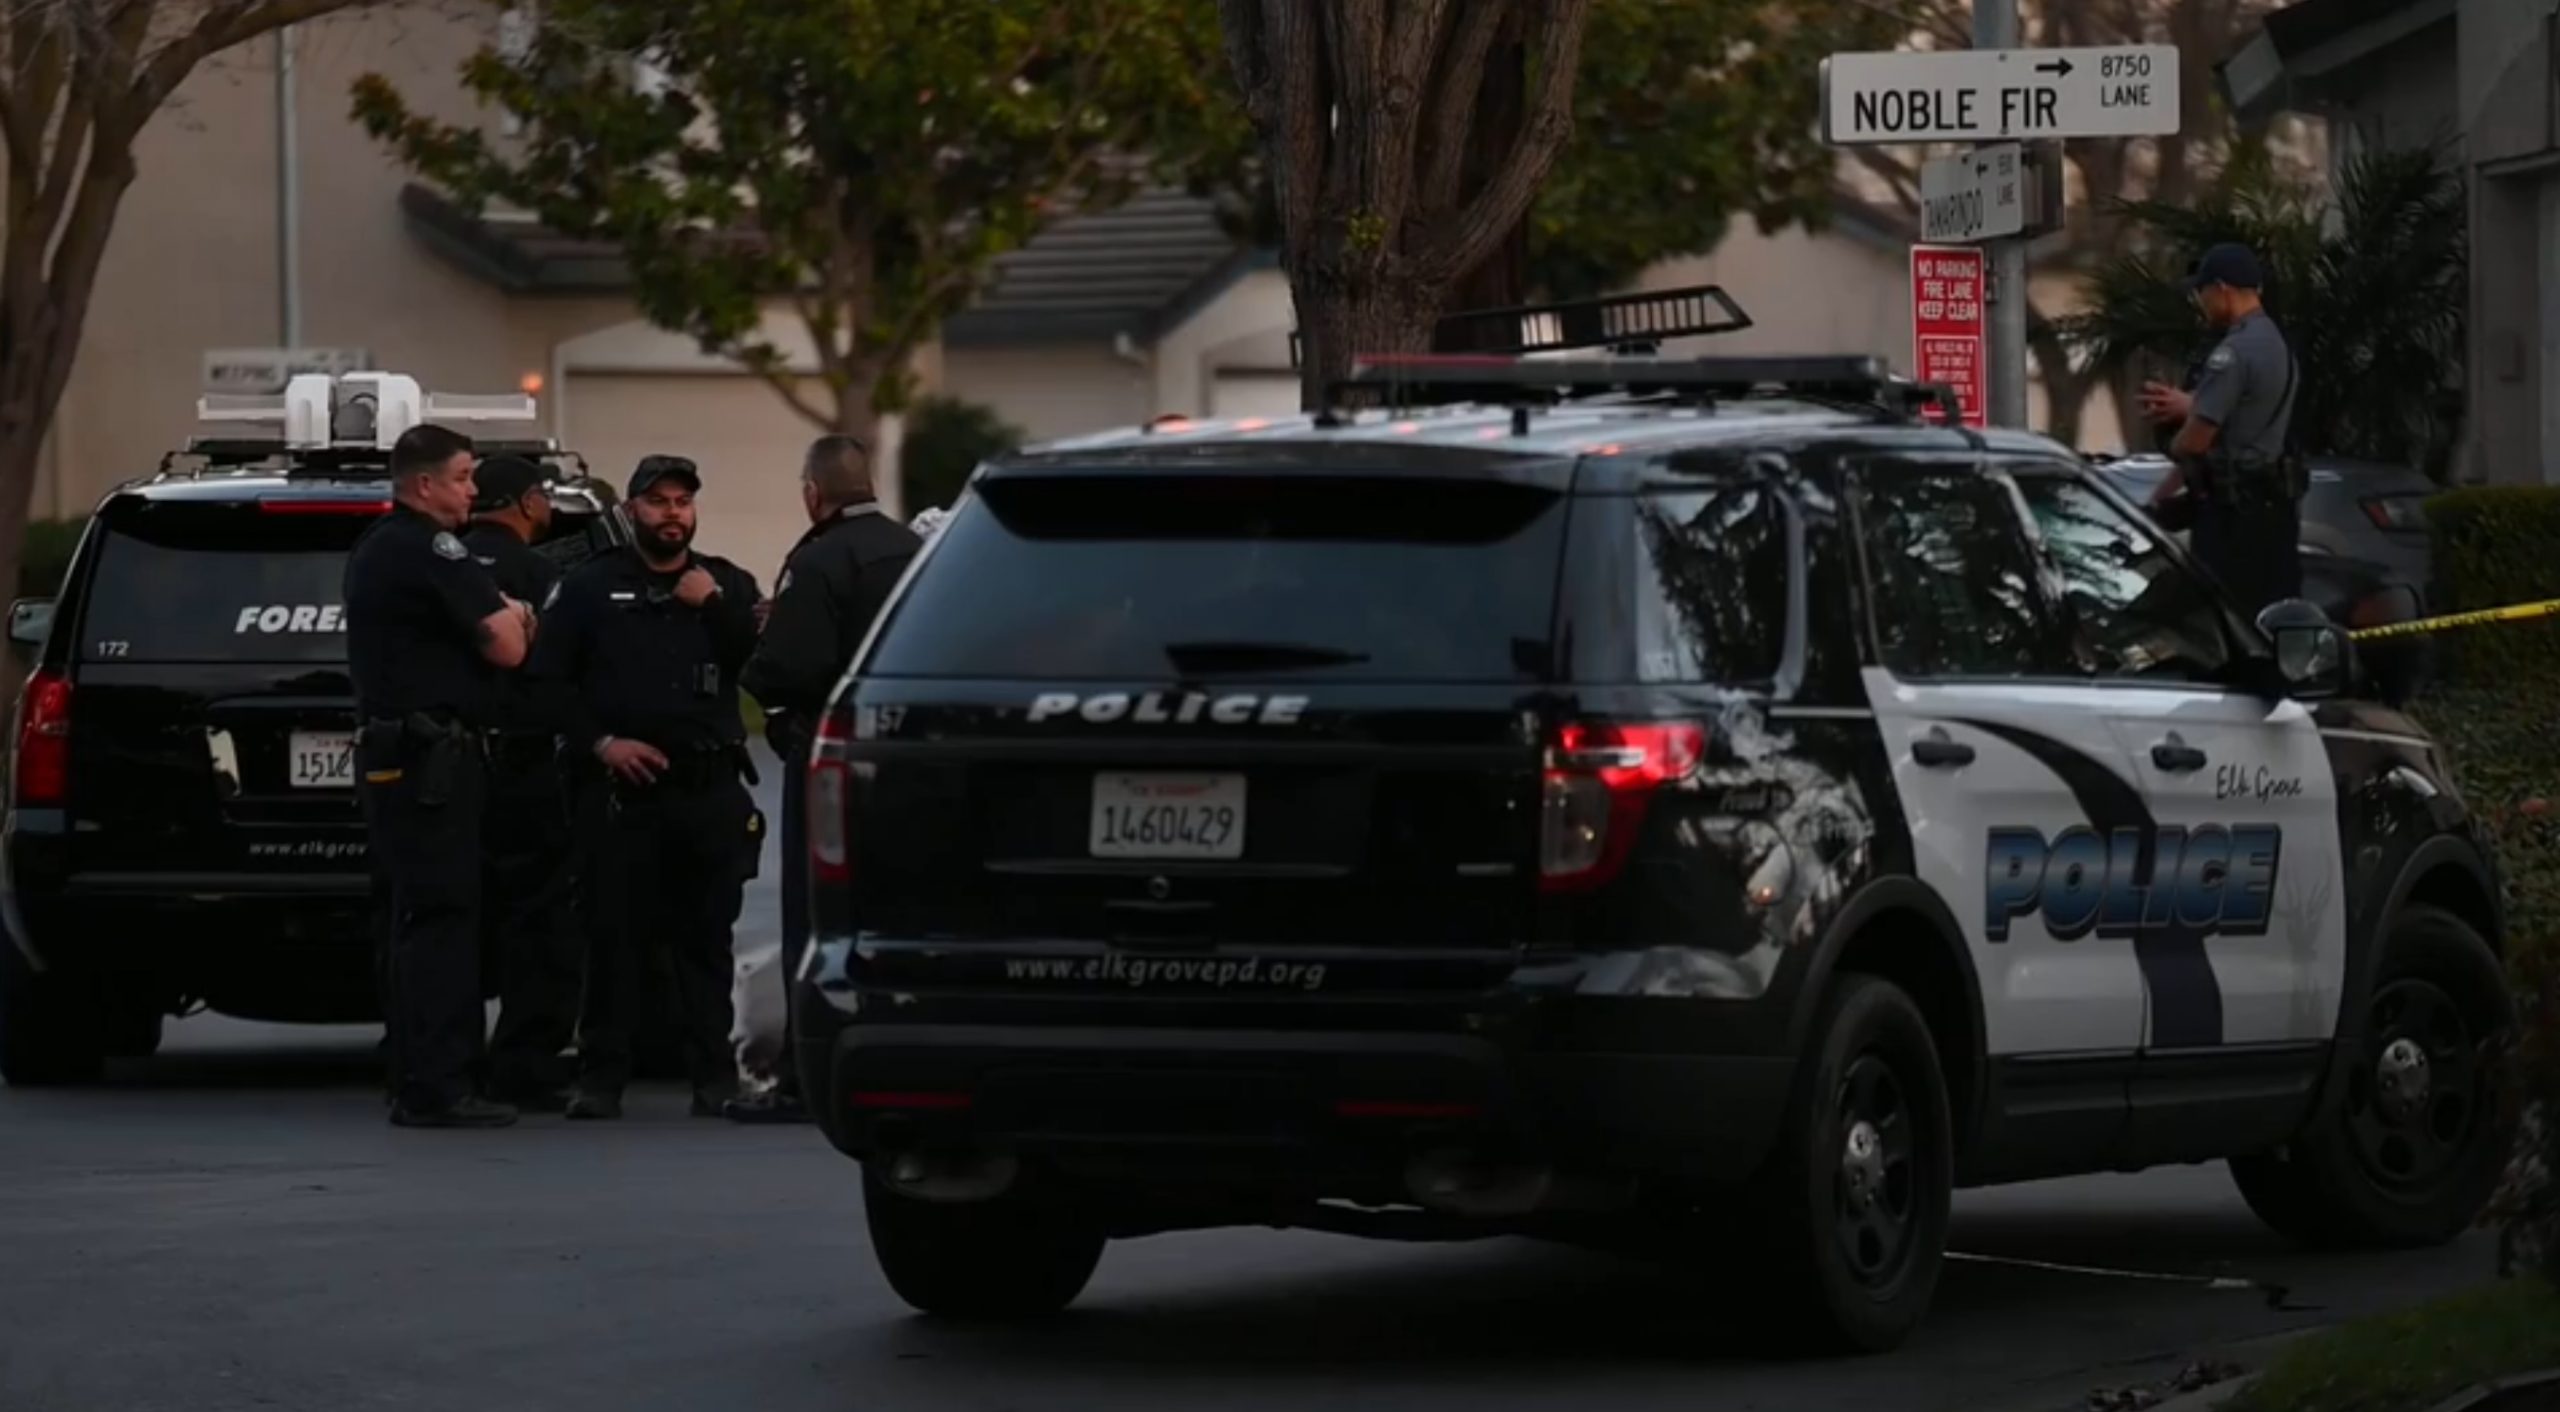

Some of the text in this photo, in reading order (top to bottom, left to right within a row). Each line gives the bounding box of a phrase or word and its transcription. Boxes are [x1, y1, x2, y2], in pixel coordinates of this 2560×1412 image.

[2100, 54, 2151, 77] 8750
[1854, 86, 2058, 132] NOBLE FIR
[2100, 84, 2151, 108] LANE
[1918, 259, 1977, 279] NO PARKING
[1923, 280, 1974, 299] FIRE LANE
[1918, 300, 1978, 320] KEEP CLEAR
[99, 641, 130, 657] 172
[1026, 692, 1311, 724] POLICE
[2216, 763, 2303, 806] Elk Grove
[1101, 804, 1235, 847] 1460429
[1985, 824, 2282, 943] POLICE
[1005, 952, 1327, 991] www.elkgrovepd.org
